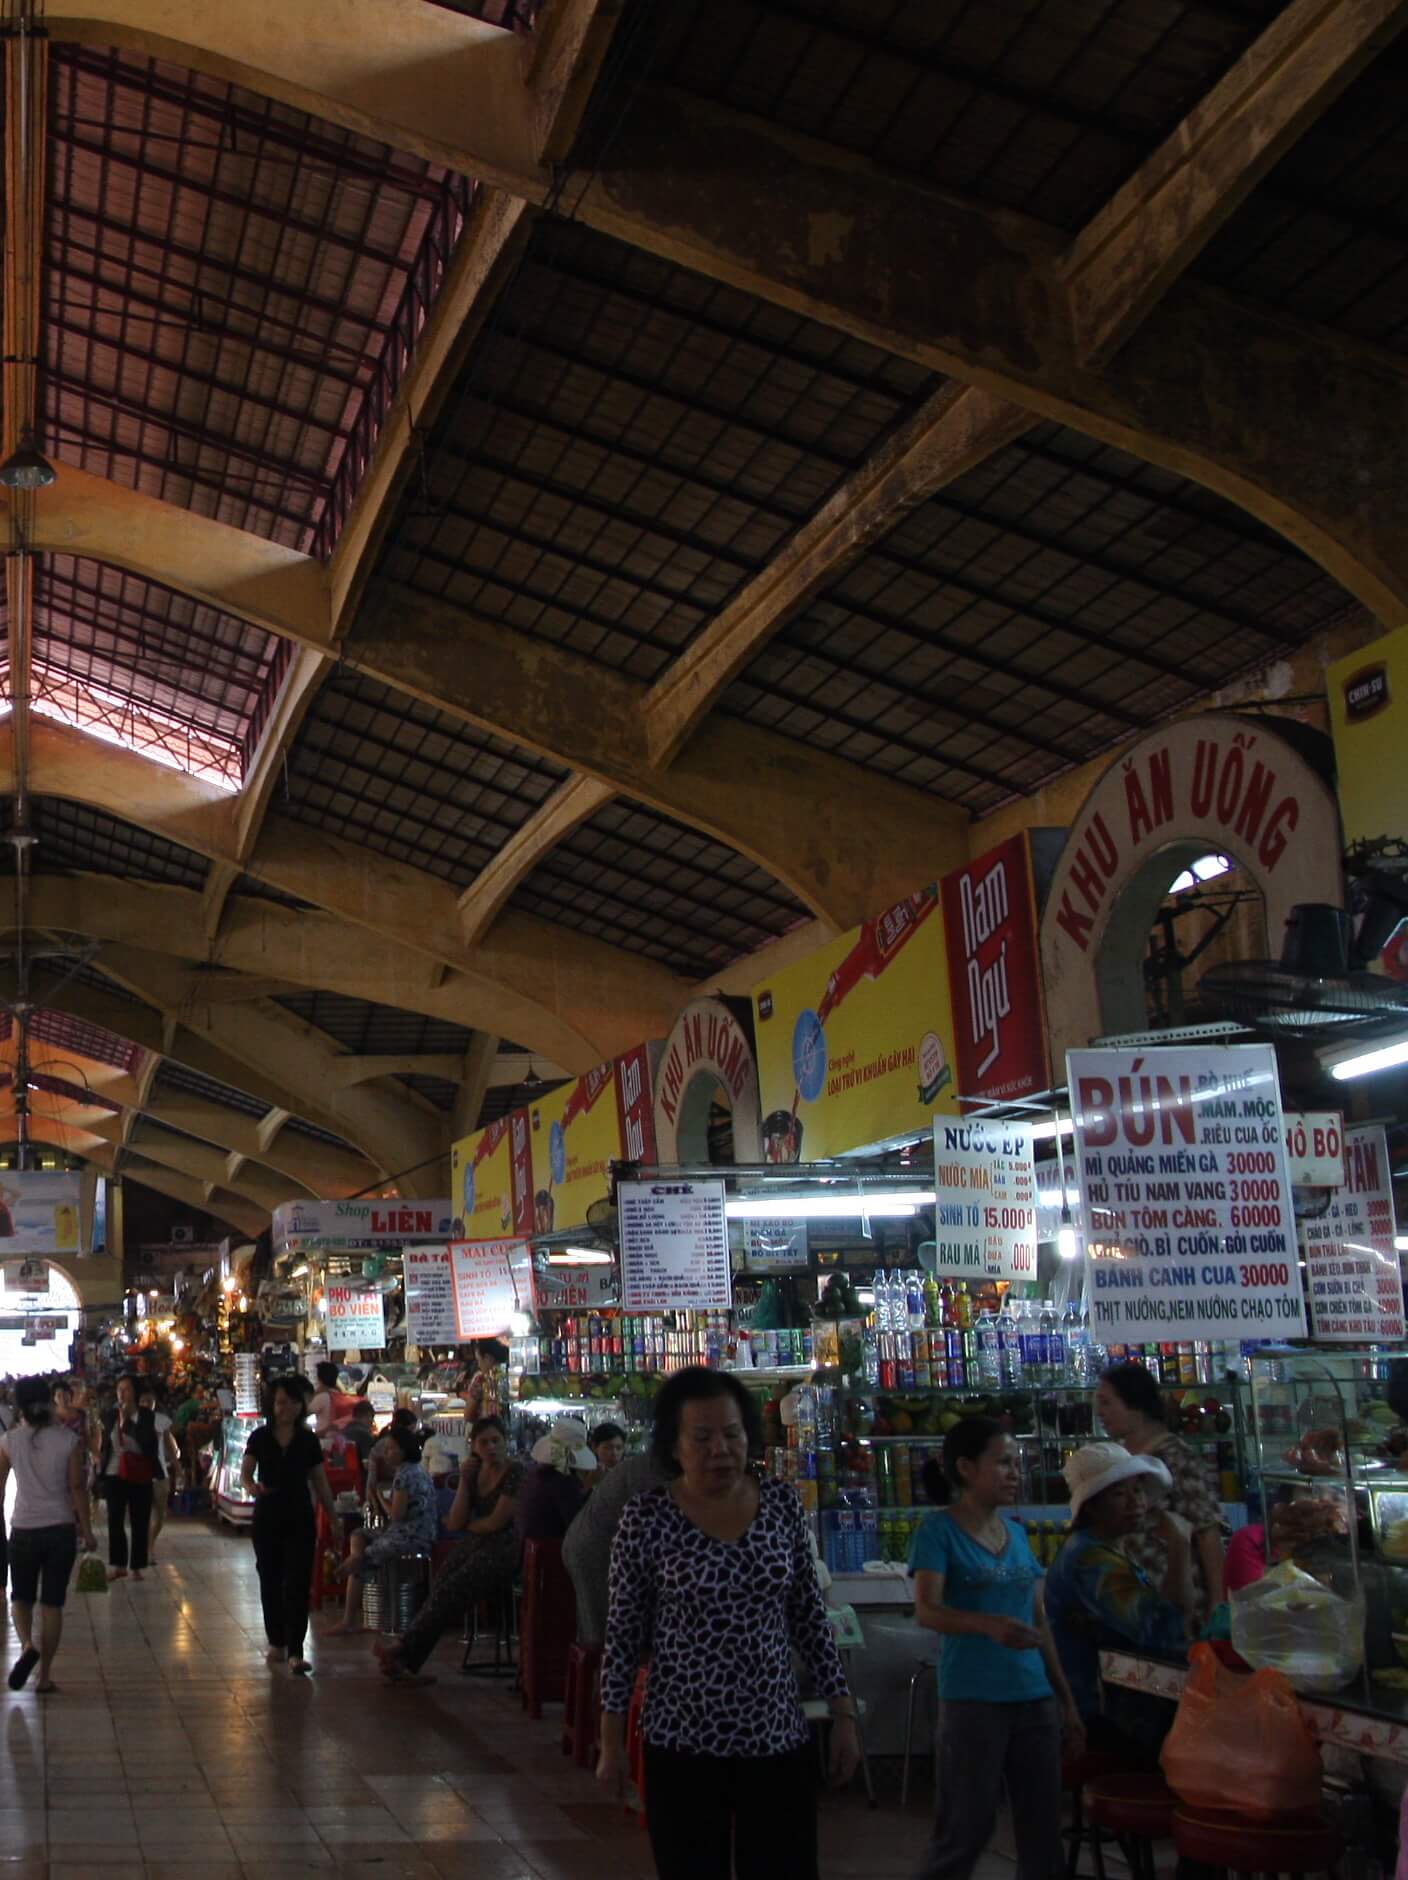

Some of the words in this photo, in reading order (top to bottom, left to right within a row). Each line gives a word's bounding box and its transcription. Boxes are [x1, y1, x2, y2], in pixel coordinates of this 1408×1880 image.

[1056, 812, 1120, 952] KHU
[1123, 744, 1175, 846] ĂN
[1192, 732, 1300, 874] UỐNG
[959, 860, 1009, 959] Nam
[661, 1066, 684, 1126] KHU
[1078, 1058, 1196, 1147] BÚN
[1235, 1127, 1258, 1144] CUA
[1085, 1151, 1102, 1176] MÌ
[1199, 1151, 1219, 1174] GÀ
[1227, 1151, 1276, 1175] 30000
[1146, 1182, 1179, 1200] NAM
[1185, 1181, 1226, 1201] VANG
[1230, 1179, 1280, 1202] 30000
[335, 1203, 370, 1220] Shop
[371, 1205, 433, 1233] LIÊN
[939, 1204, 963, 1226] SINH
[1130, 1205, 1168, 1229] TÔM
[1231, 1204, 1281, 1228] 60000
[940, 1243, 961, 1266] RAU
[1251, 1231, 1286, 1254] CUỐN
[1095, 1261, 1143, 1288] BÁNH
[1149, 1265, 1195, 1287] CANH
[1202, 1265, 1236, 1286] CUA
[1240, 1263, 1289, 1287] 30000
